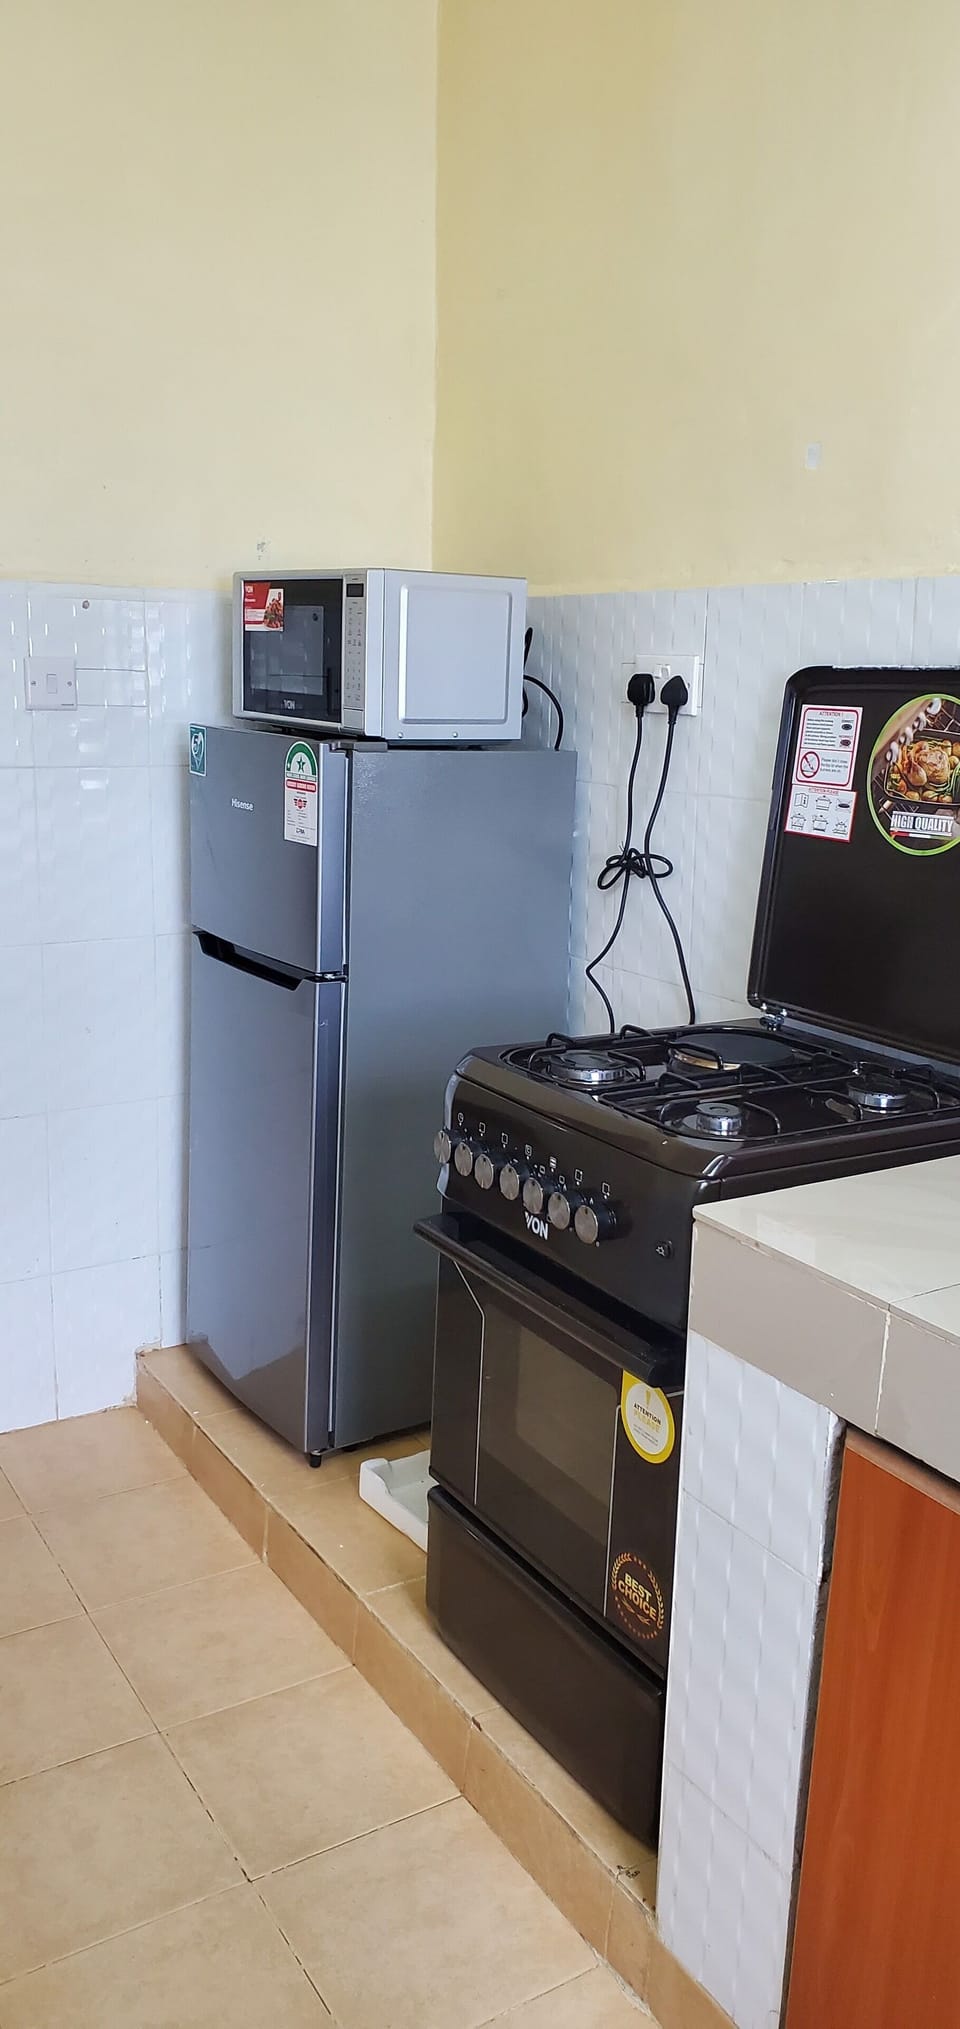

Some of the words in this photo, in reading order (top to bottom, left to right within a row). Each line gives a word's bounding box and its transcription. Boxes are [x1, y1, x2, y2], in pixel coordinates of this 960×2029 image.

[231, 797, 254, 811] Hisense
[891, 814, 914, 829] HIGH
[914, 816, 953, 832] QUALITY
[525, 1212, 549, 1241] VON
[633, 1402, 661, 1425] ATTENTION
[618, 1580, 656, 1621] CHOICE
[624, 1573, 652, 1602] BEST
